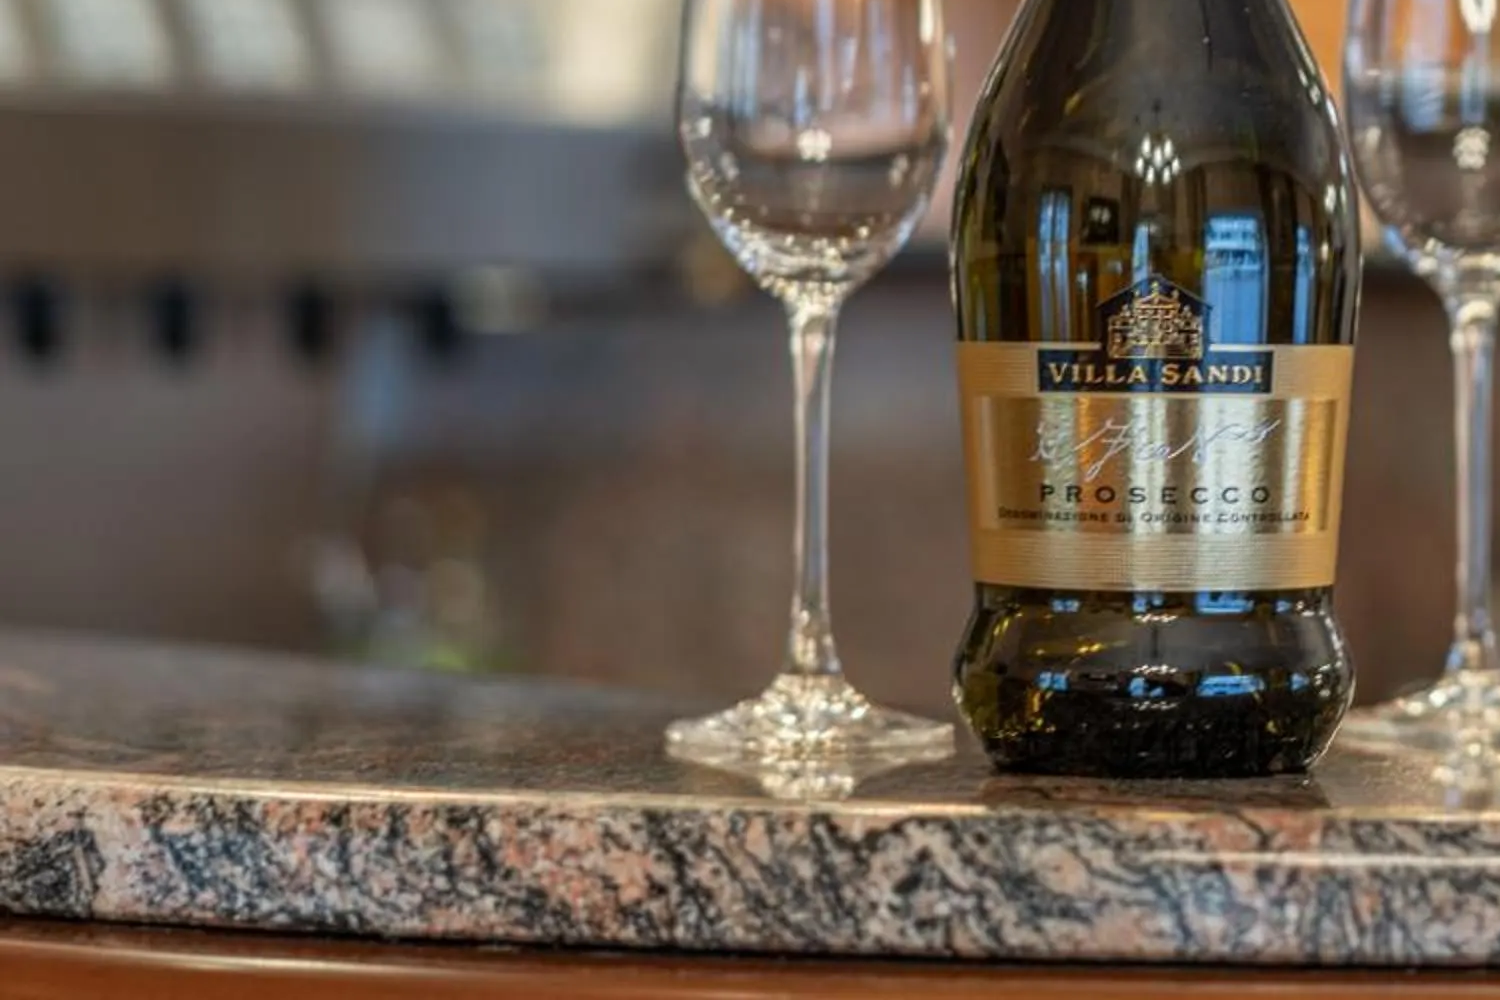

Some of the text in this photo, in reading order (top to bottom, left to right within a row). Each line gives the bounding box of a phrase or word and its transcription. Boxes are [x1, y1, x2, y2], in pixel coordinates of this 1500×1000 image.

[1047, 362, 1263, 386] VILLA SANDI
[1040, 484, 1271, 505] PROSECCO
